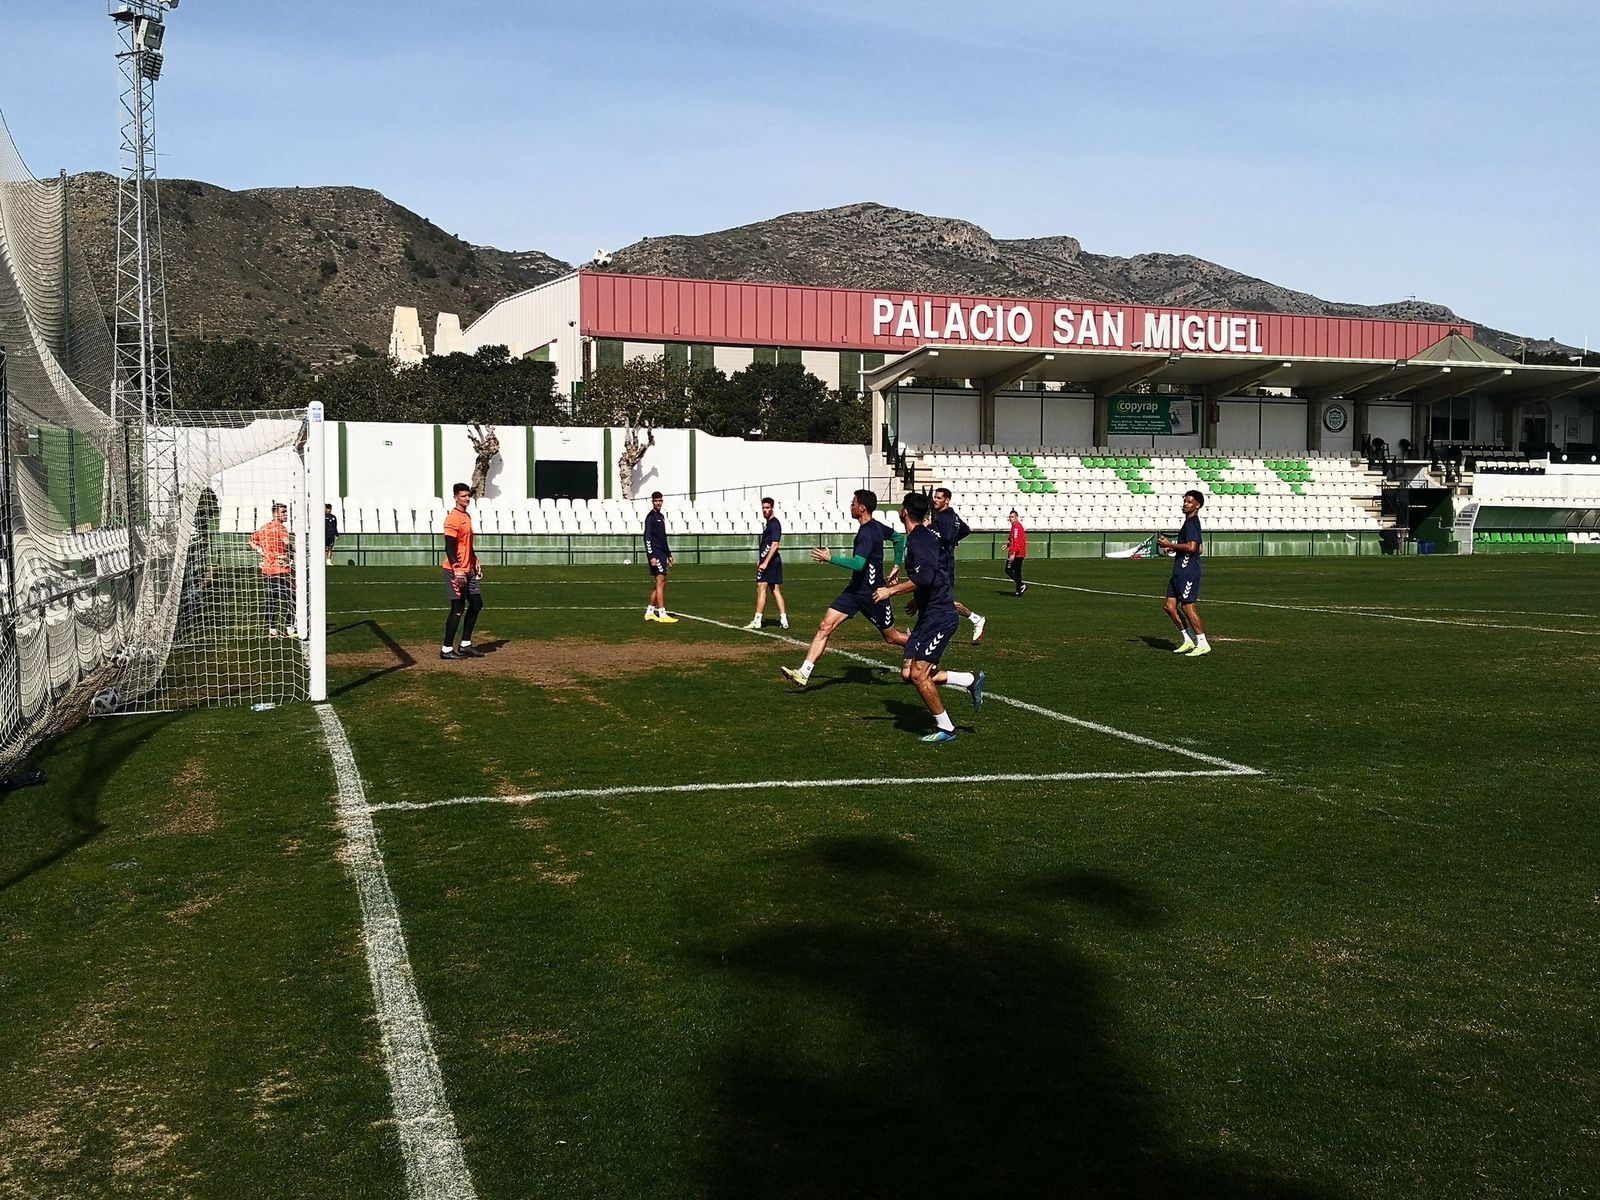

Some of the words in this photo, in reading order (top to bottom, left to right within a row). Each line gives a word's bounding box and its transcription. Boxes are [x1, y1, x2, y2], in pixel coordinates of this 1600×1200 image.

[873, 298, 1033, 343] PALACIO
[1053, 308, 1124, 347] SAN
[1144, 312, 1263, 353] MIGUEL
